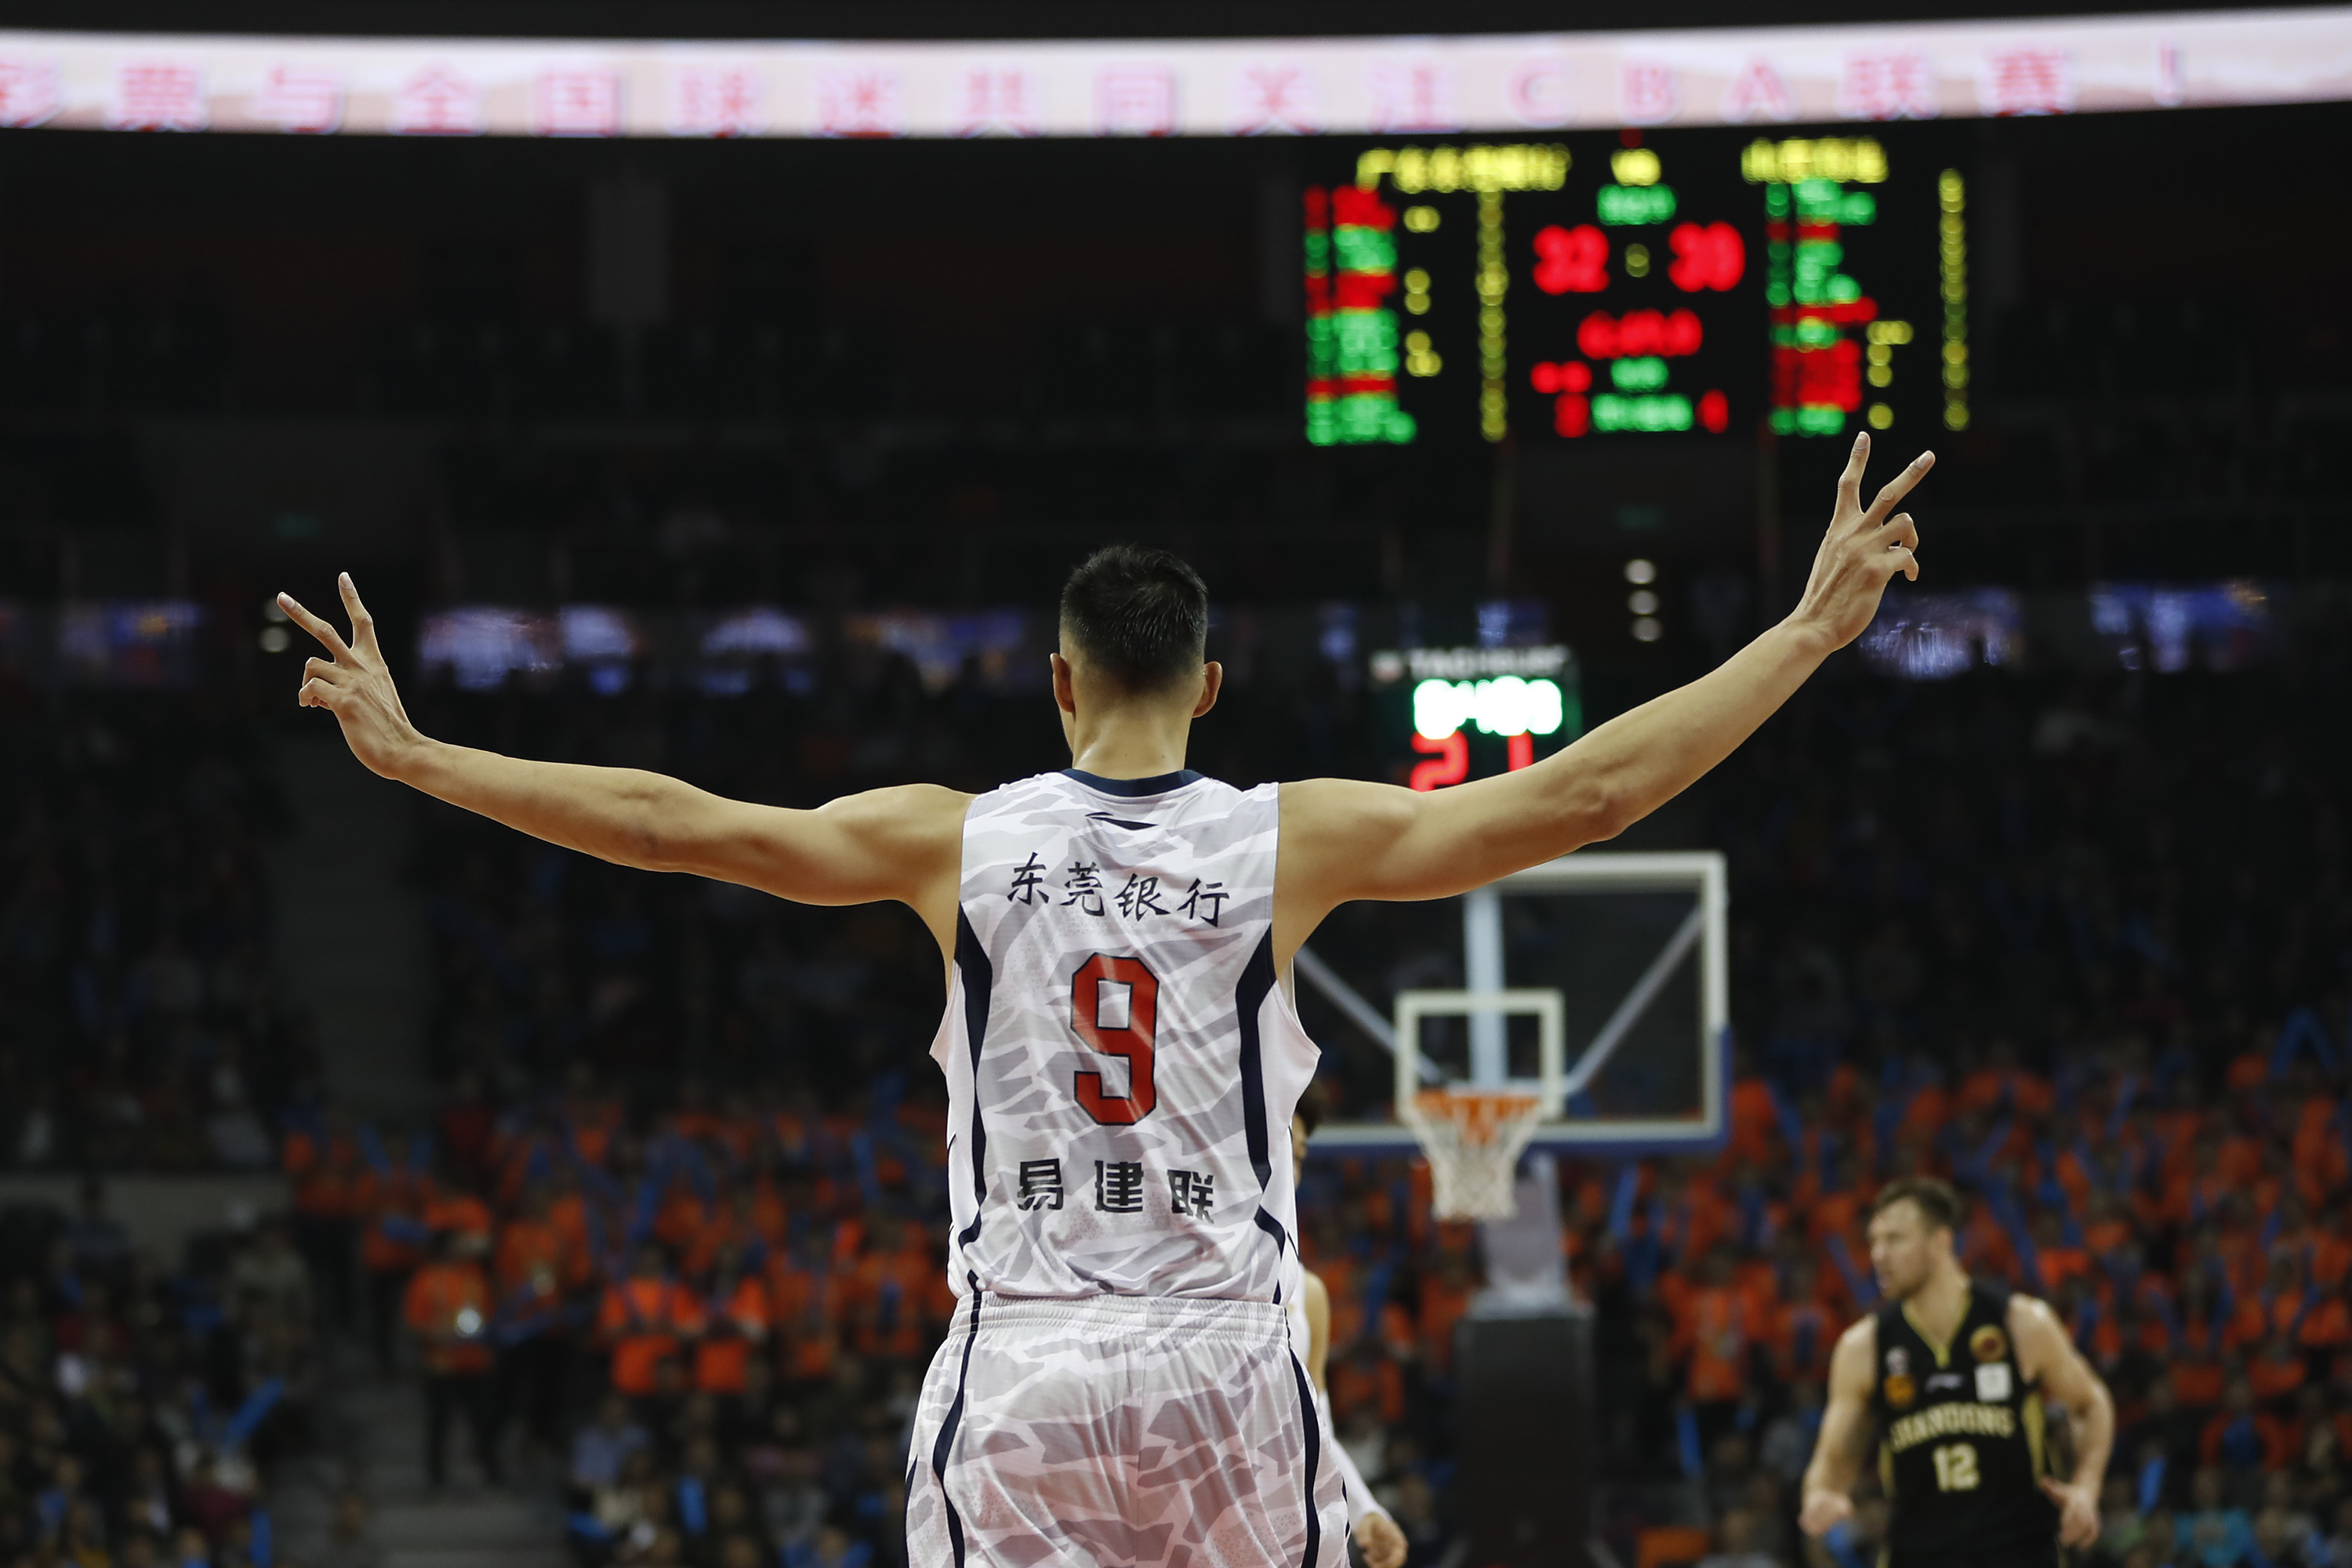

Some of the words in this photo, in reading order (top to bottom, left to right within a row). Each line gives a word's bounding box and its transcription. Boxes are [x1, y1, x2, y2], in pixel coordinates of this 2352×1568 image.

[1007, 852, 1229, 927] 东莞银行
[1071, 952, 1159, 1126] 9
[1017, 1159, 1214, 1223] 易建联
[1890, 1402, 2014, 1453] SHANDONG
[1933, 1443, 1980, 1492] 12
